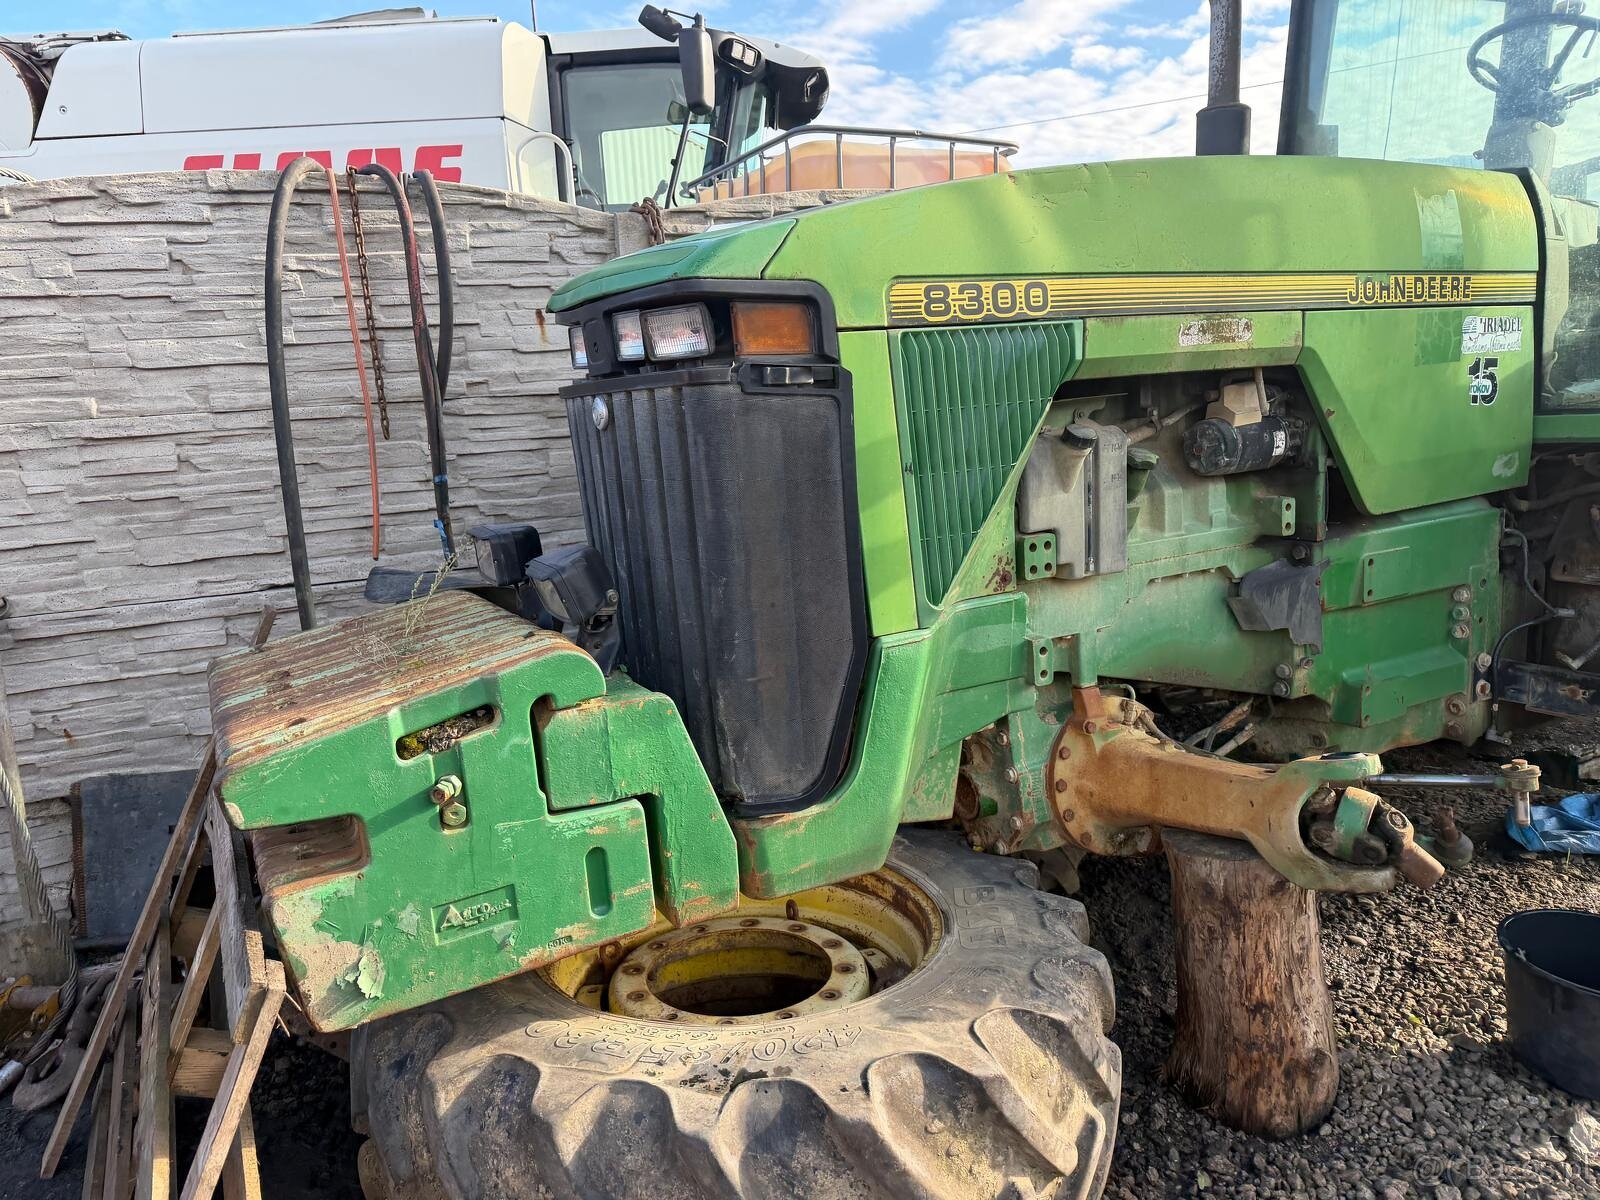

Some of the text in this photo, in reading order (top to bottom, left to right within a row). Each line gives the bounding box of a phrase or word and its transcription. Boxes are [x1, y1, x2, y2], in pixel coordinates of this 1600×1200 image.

[921, 281, 1051, 322] 8300
[1347, 274, 1473, 304] JOHN DEERE
[1467, 356, 1499, 406] 15
